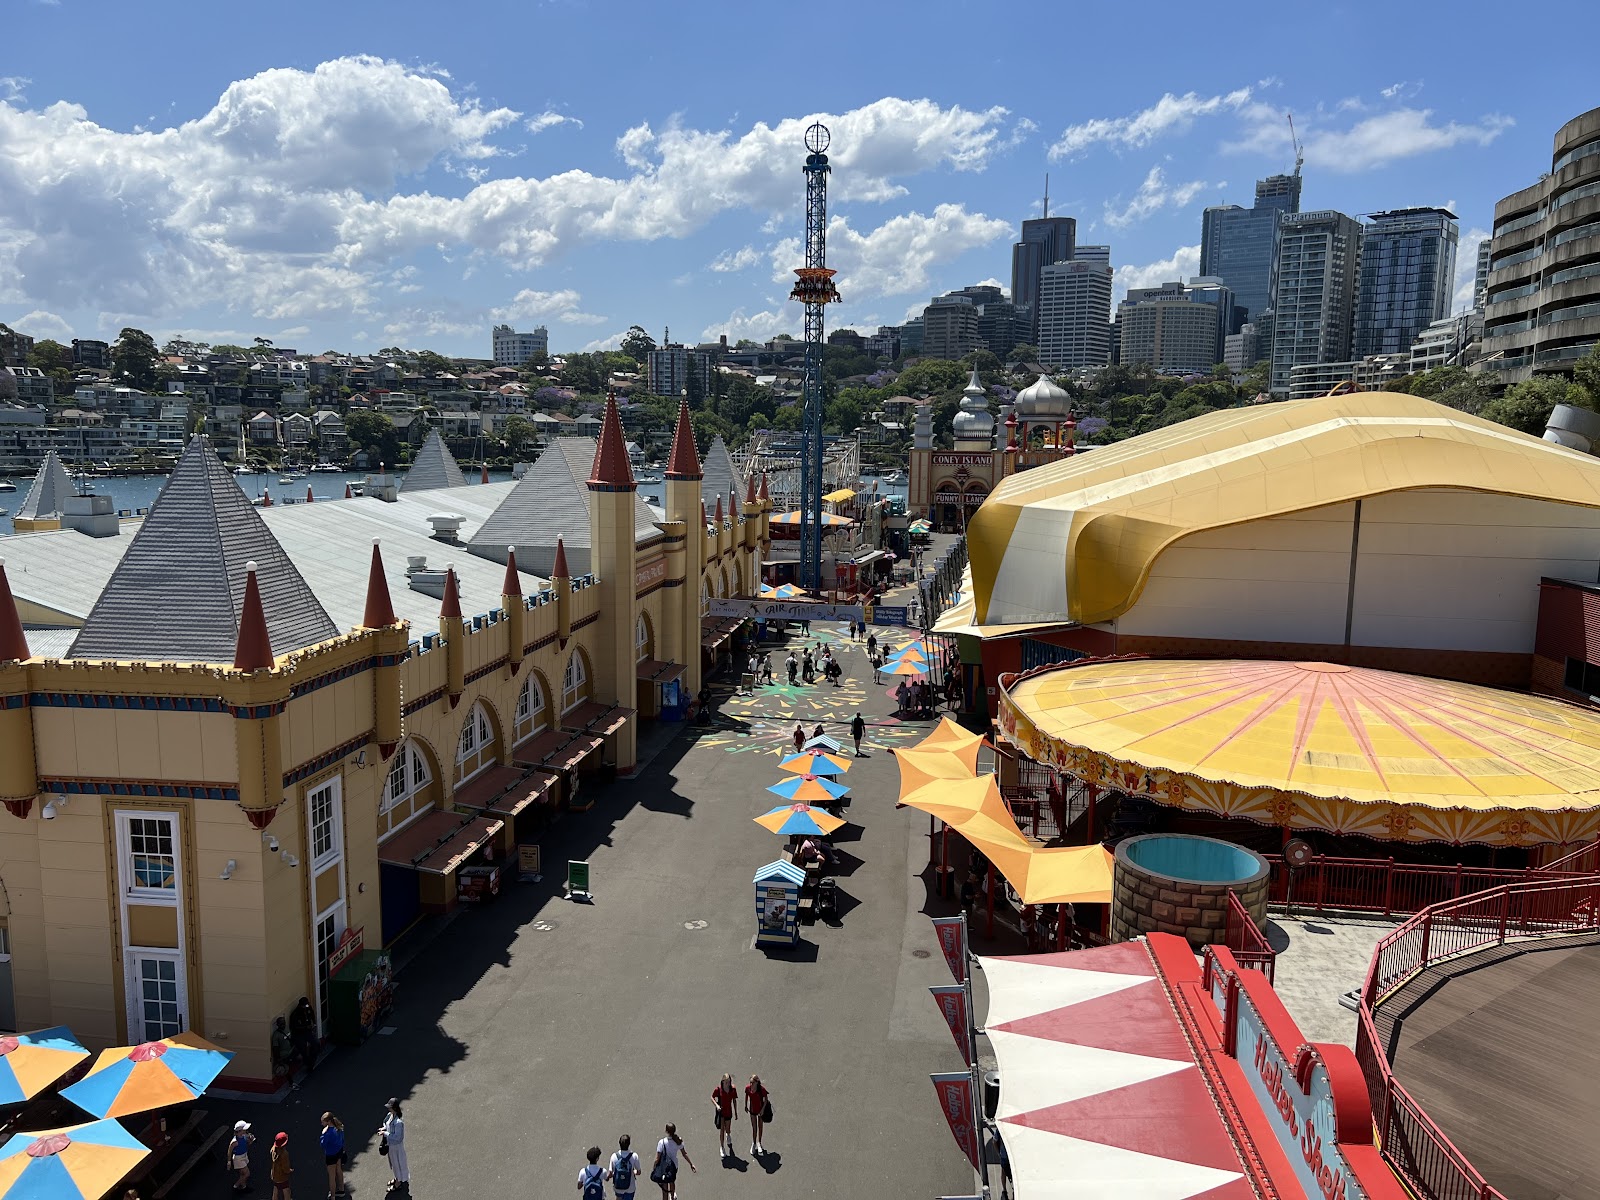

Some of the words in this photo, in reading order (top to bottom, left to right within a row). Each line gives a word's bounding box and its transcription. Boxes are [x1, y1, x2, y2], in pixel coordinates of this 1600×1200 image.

[1291, 212, 1331, 221] Platinum
[1143, 289, 1176, 299] opentext
[933, 455, 960, 464] CONEY
[962, 455, 993, 465] ISLAND
[936, 494, 959, 503] FUNNY
[965, 495, 985, 503] LAND
[765, 604, 787, 615] AIR
[788, 605, 817, 617] TIME
[1254, 1032, 1299, 1139] Helter
[946, 1084, 960, 1120] Helter
